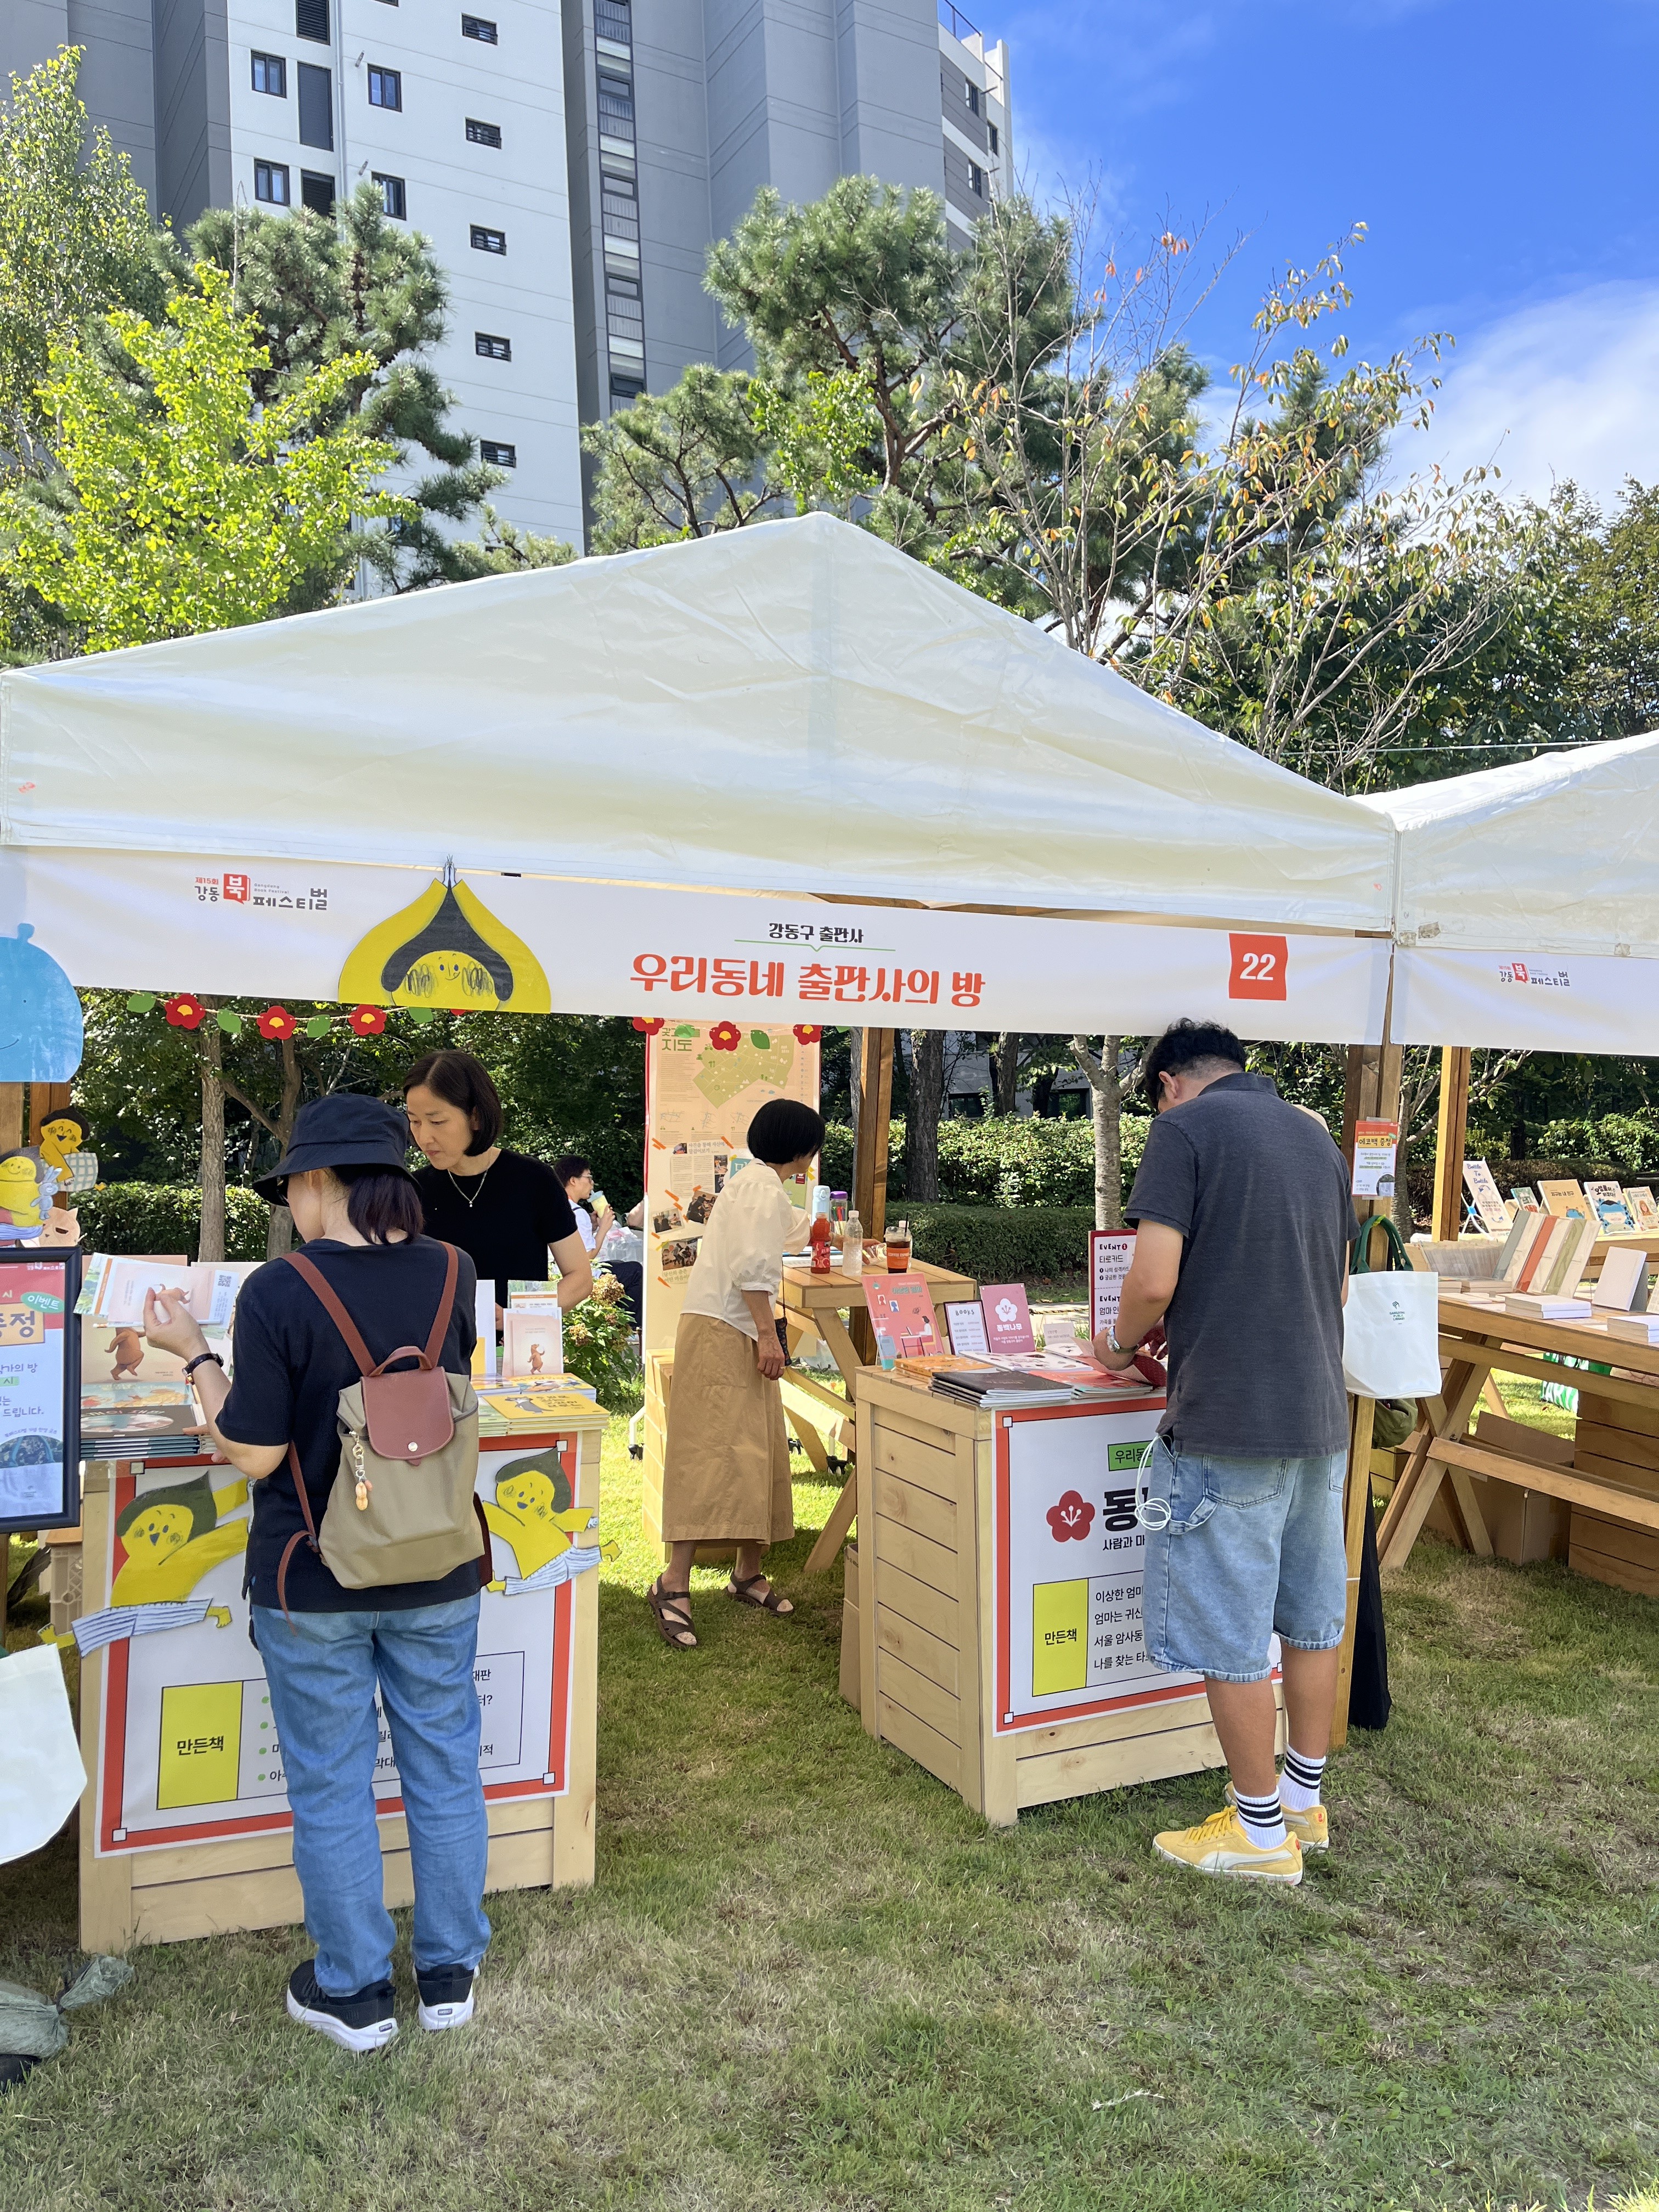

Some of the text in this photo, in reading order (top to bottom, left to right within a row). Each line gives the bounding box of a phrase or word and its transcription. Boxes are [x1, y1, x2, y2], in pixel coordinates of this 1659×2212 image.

[195, 877, 219, 885] 제15회
[194, 876, 328, 911] 강동 북 페스티벌
[769, 923, 864, 943] 강동구 출판사
[1239, 952, 1276, 981] 22
[630, 953, 986, 1007] 우리동네 출판사의 방
[1499, 971, 1513, 983] 강동
[1515, 964, 1525, 980] 북
[1531, 971, 1570, 986] 페스티벌
[662, 1039, 692, 1051] 지도
[1380, 1138, 1391, 1146] 증정
[1099, 1255, 1123, 1263] 타로카드
[27, 1295, 60, 1310] 이벤트
[1099, 1307, 1112, 1315] 엄마
[997, 1323, 1022, 1331] 동백나무
[27, 1363, 37, 1373] 방
[3, 1406, 44, 1418] 드립니다.
[1103, 1536, 1133, 1551] 사람과
[1096, 1588, 1124, 1603] 이상한
[1094, 1611, 1123, 1625] 엄마는
[1045, 1628, 1077, 1646] 만든책
[1094, 1629, 1143, 1647] 서울 암사동
[1094, 1657, 1113, 1670] 나를
[1115, 1654, 1134, 1667] 찾는
[177, 1735, 224, 1756] 만든책
